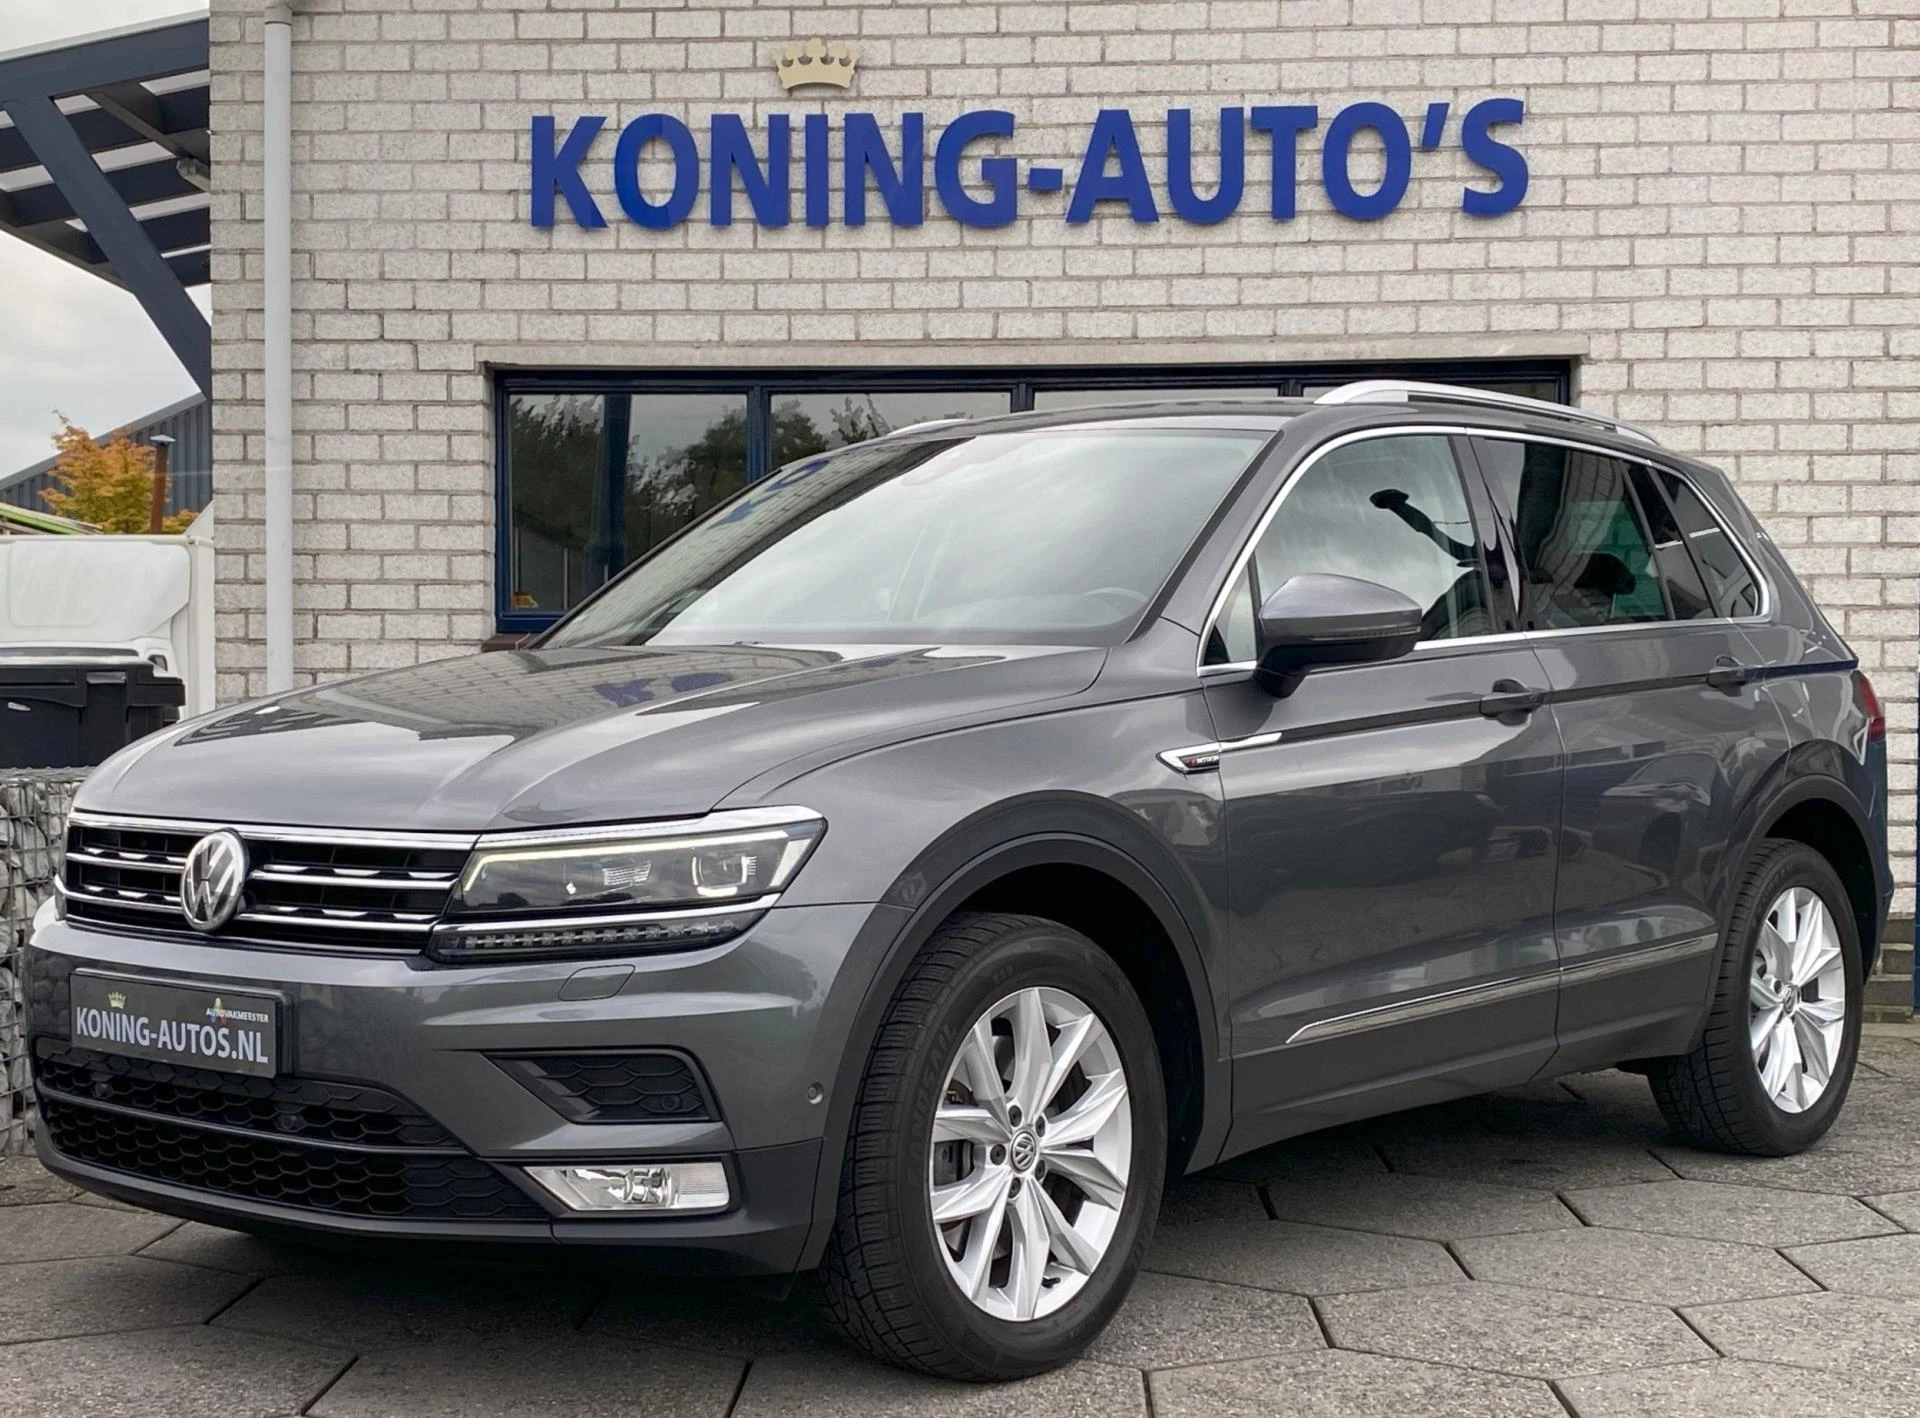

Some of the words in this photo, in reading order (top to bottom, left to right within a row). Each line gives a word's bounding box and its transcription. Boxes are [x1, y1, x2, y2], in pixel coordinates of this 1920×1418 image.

[531, 97, 1529, 229] KONING-AUTO'S
[76, 1007, 268, 1063] KONING-AUTOS.NL
[206, 1007, 269, 1024] AUTOVAKMEESTER
